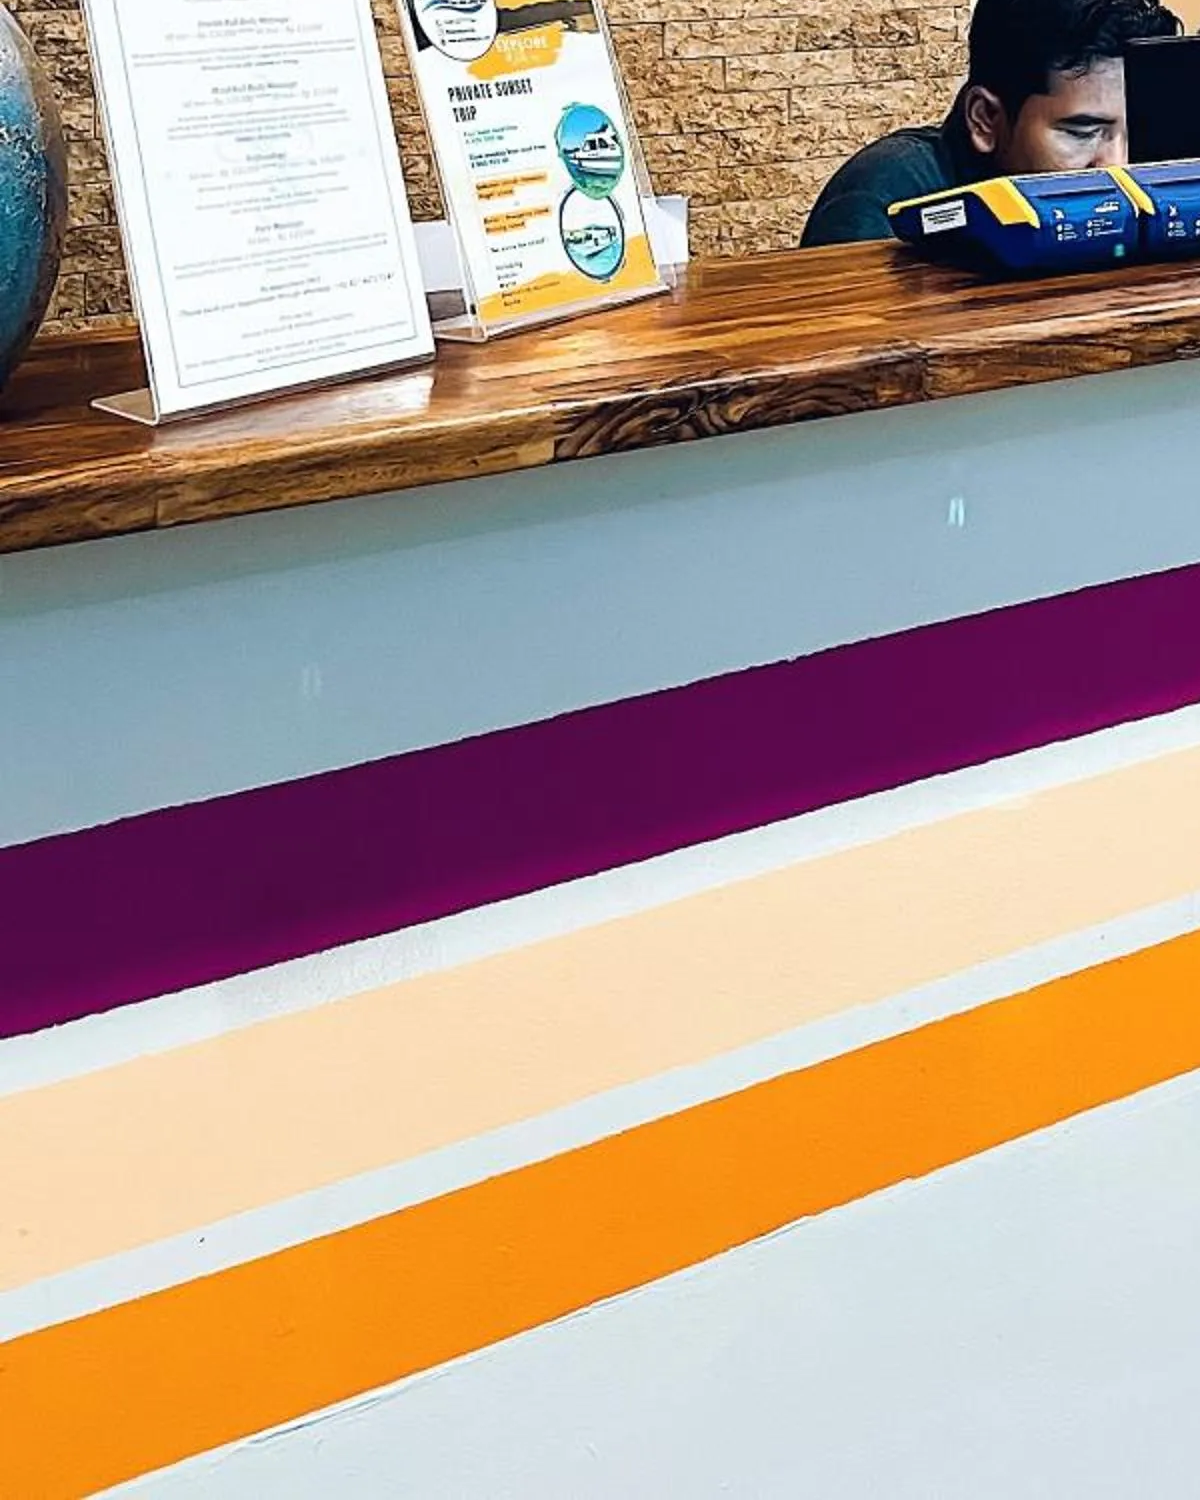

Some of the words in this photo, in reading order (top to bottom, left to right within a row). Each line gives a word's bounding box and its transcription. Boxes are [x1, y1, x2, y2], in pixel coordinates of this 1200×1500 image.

[447, 81, 493, 102] PRIVATE
[494, 77, 533, 97] SUNSET
[452, 105, 477, 123] TRIP
